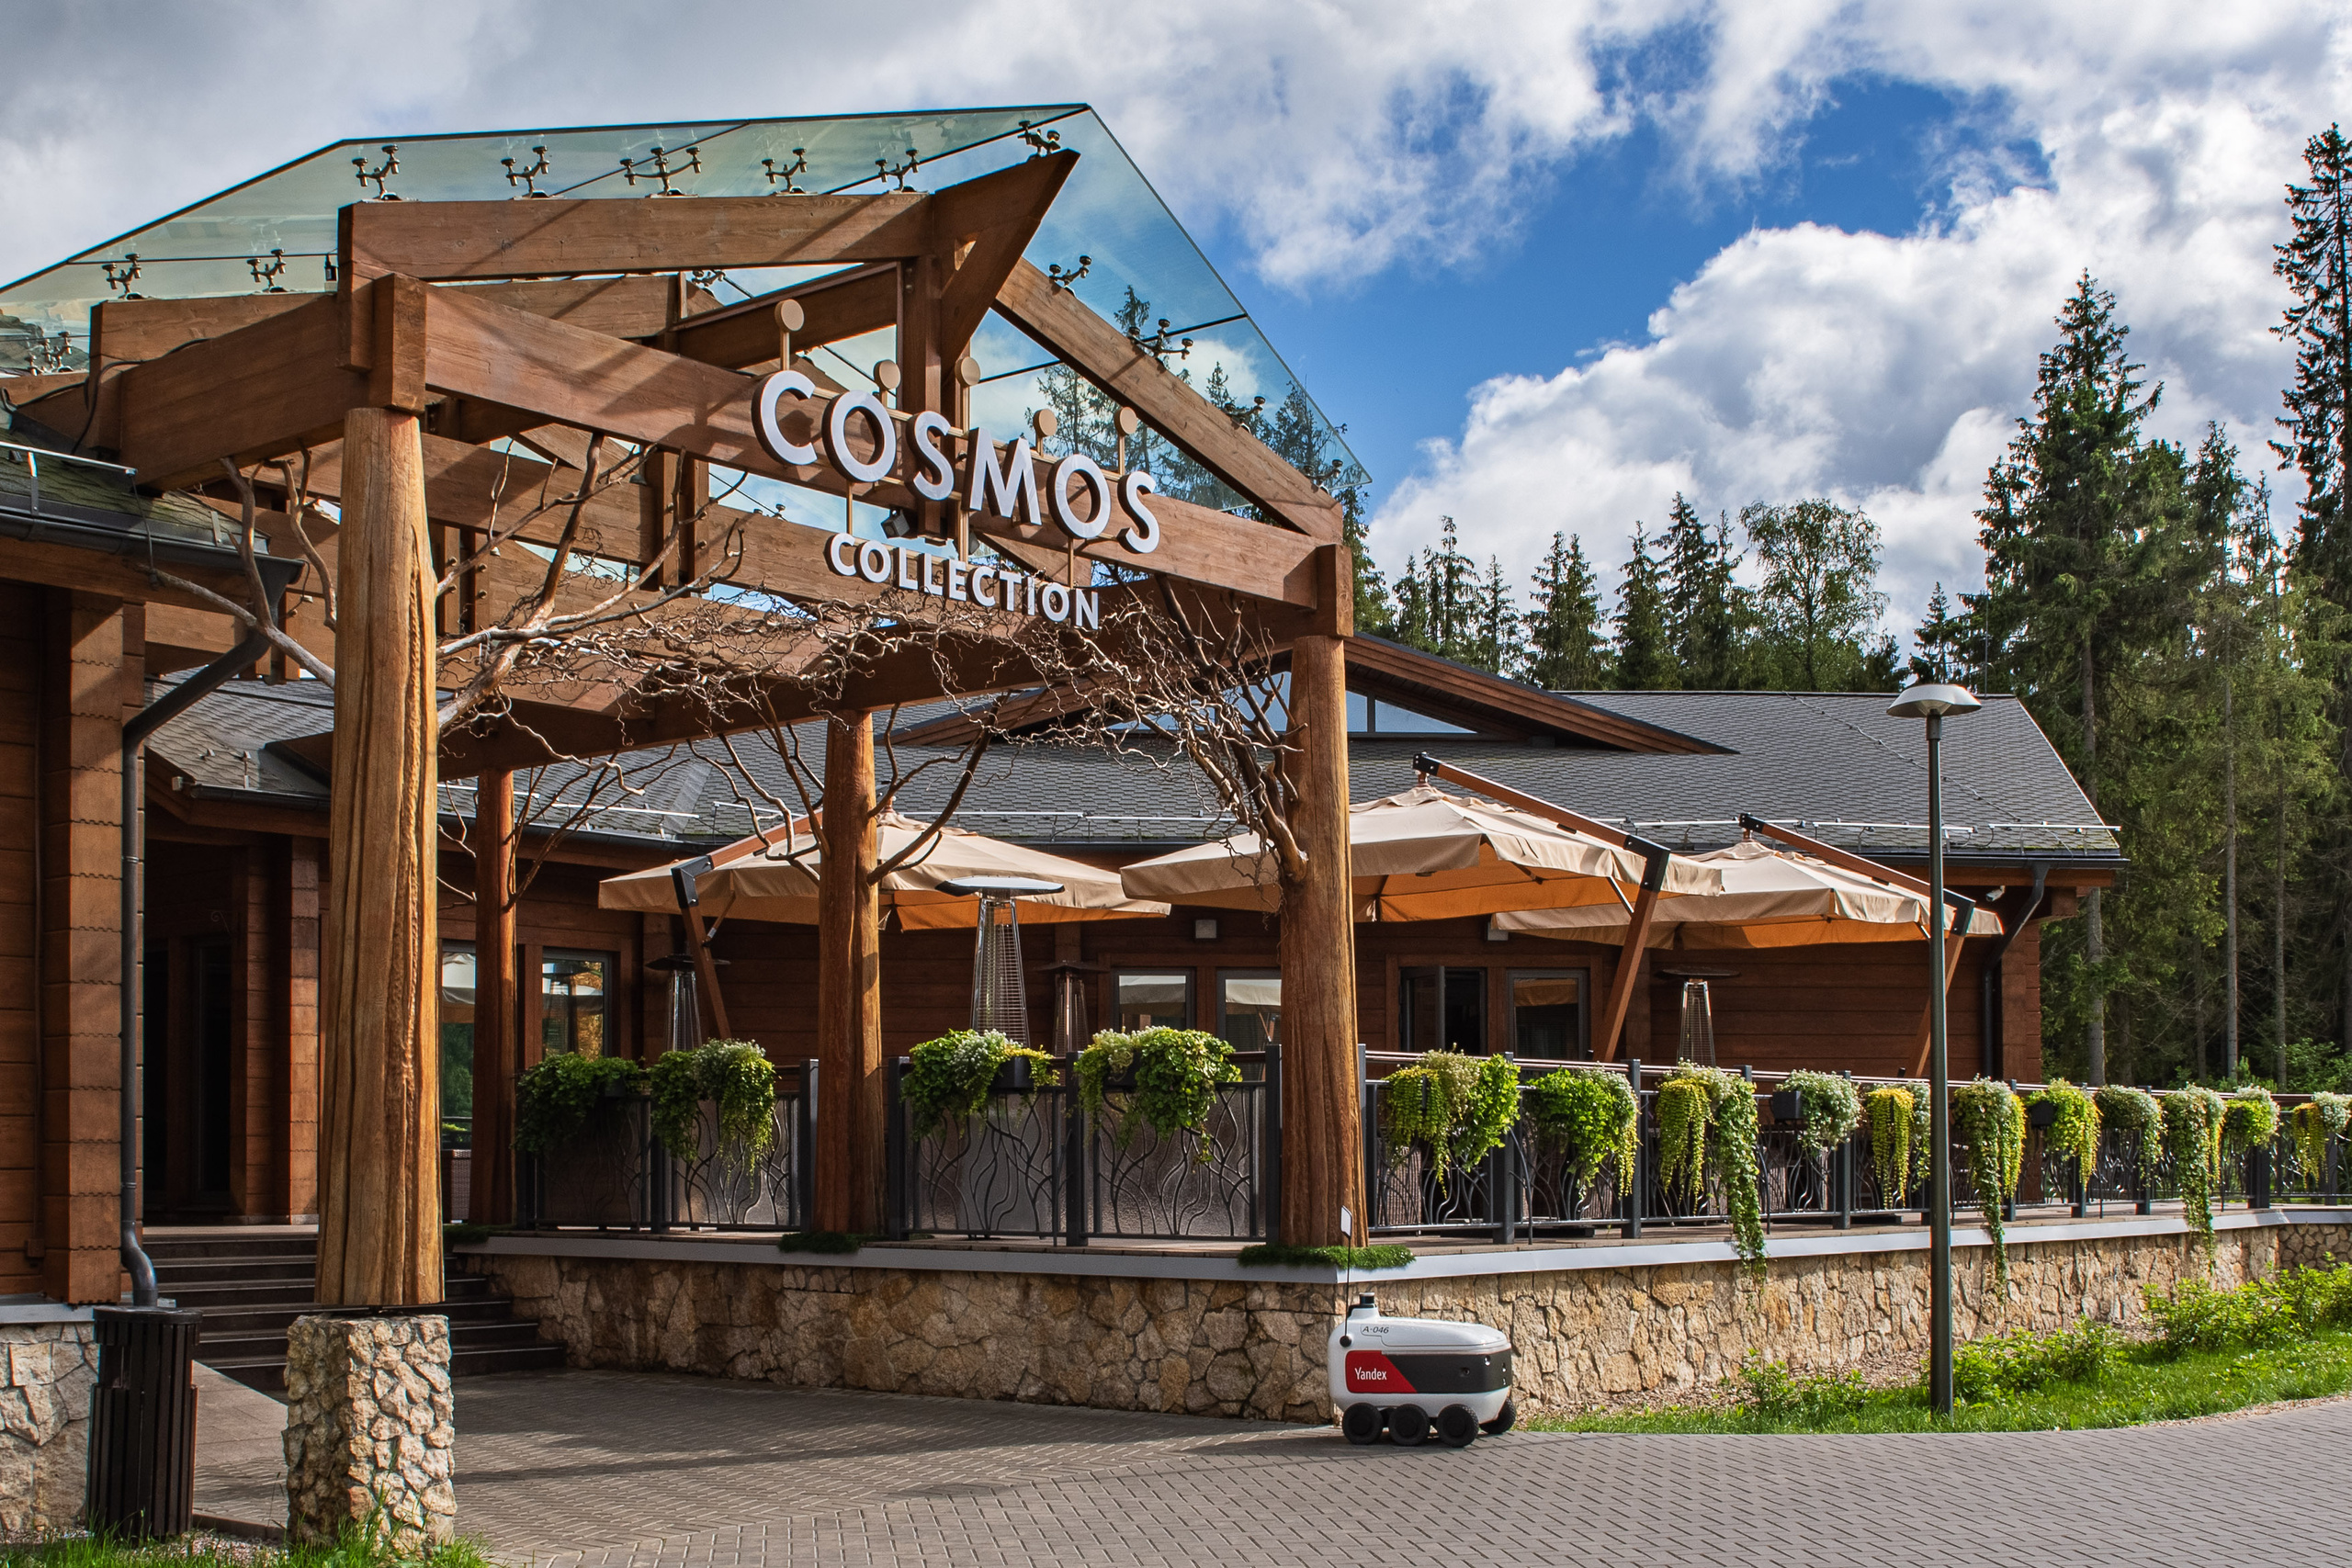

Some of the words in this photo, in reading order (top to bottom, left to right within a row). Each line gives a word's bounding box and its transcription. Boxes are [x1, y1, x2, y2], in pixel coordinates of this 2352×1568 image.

[753, 370, 1160, 553] COSMOS
[826, 533, 1099, 629] COLLECTION
[1354, 1367, 1387, 1380] Yandex
